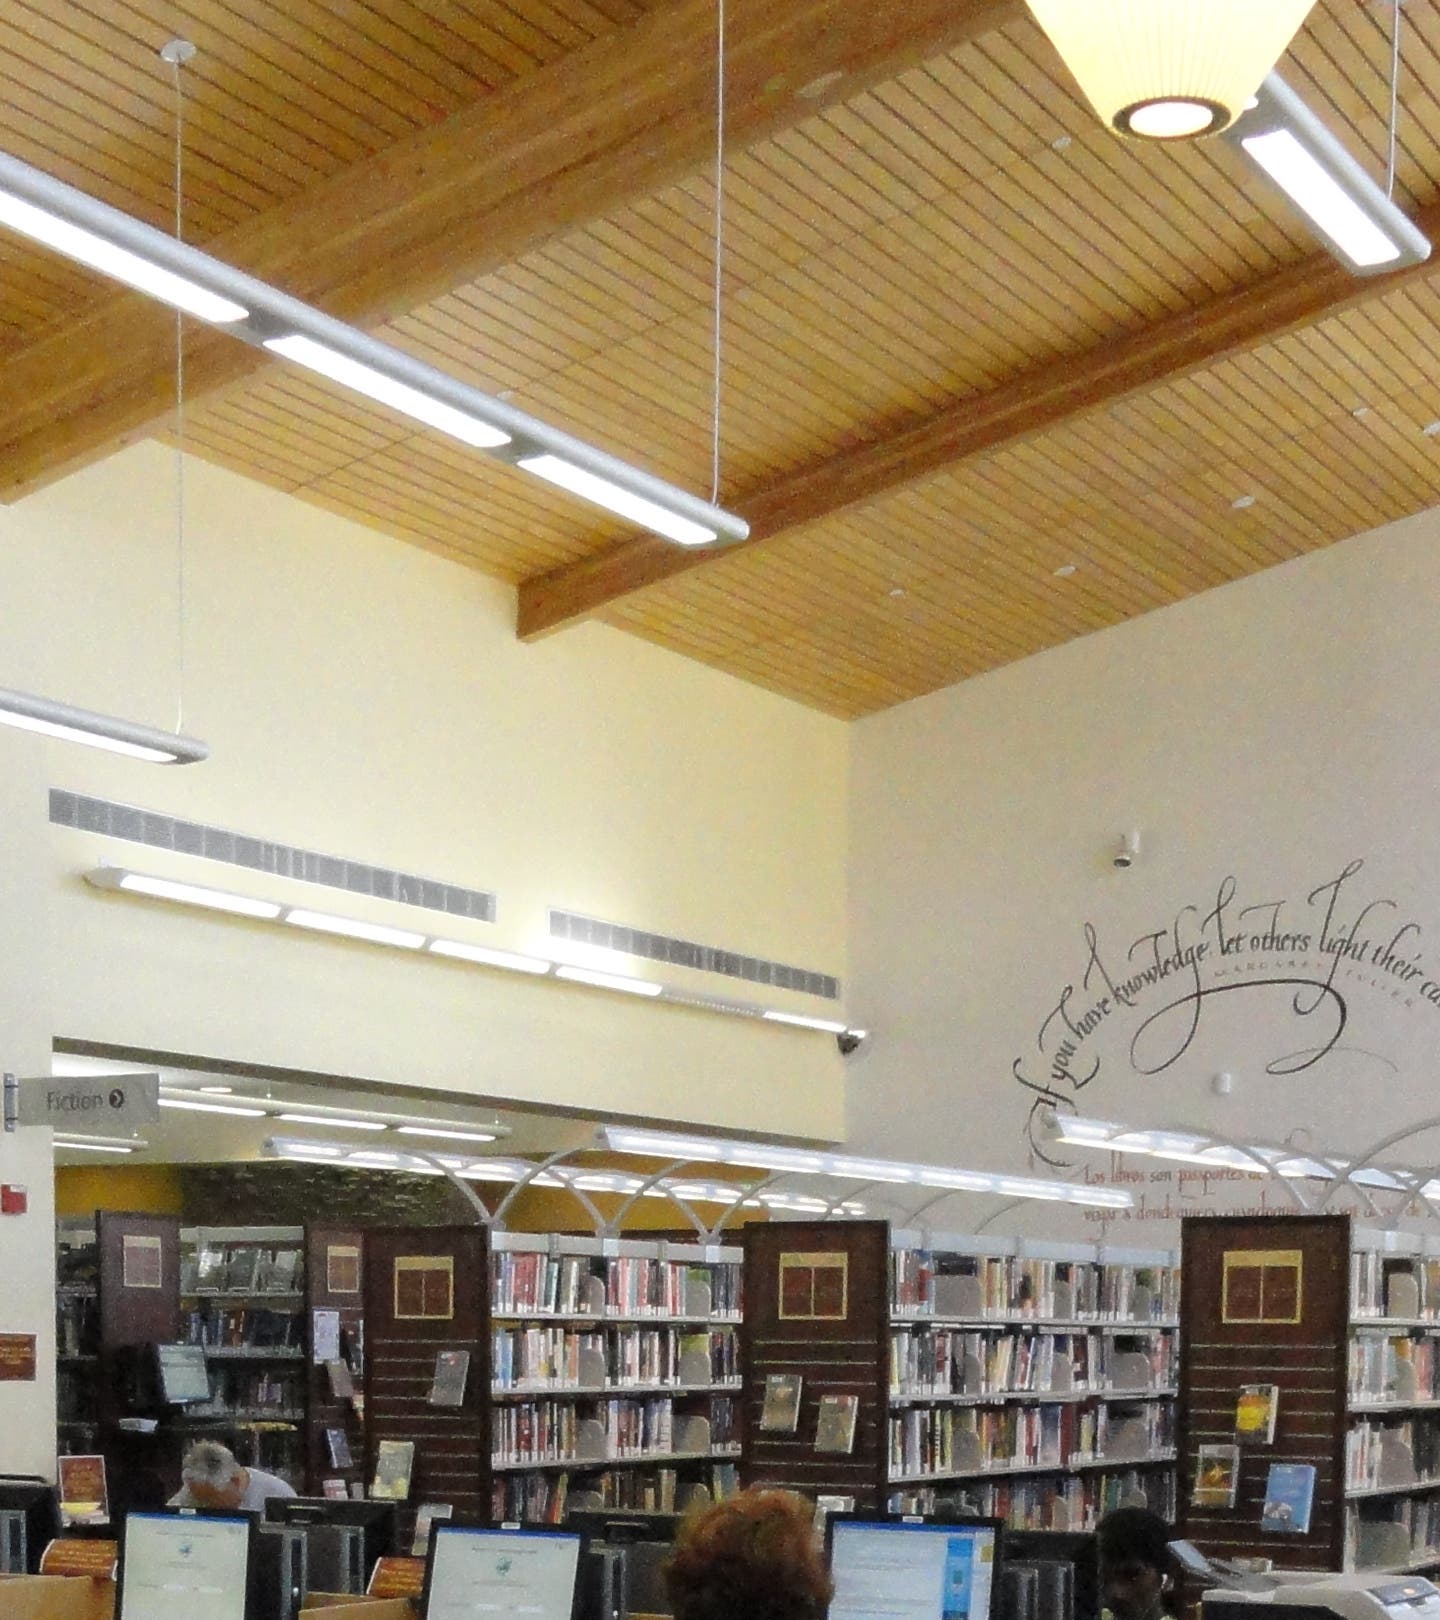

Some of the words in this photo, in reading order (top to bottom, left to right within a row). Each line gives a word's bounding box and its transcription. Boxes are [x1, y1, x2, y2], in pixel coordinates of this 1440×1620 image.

[1201, 875, 1245, 956] let
[1239, 900, 1311, 953] others
[1371, 923, 1424, 982] their
[1039, 985, 1112, 1052] have
[1050, 1037, 1101, 1091] you
[46, 1089, 104, 1112] Fiction
